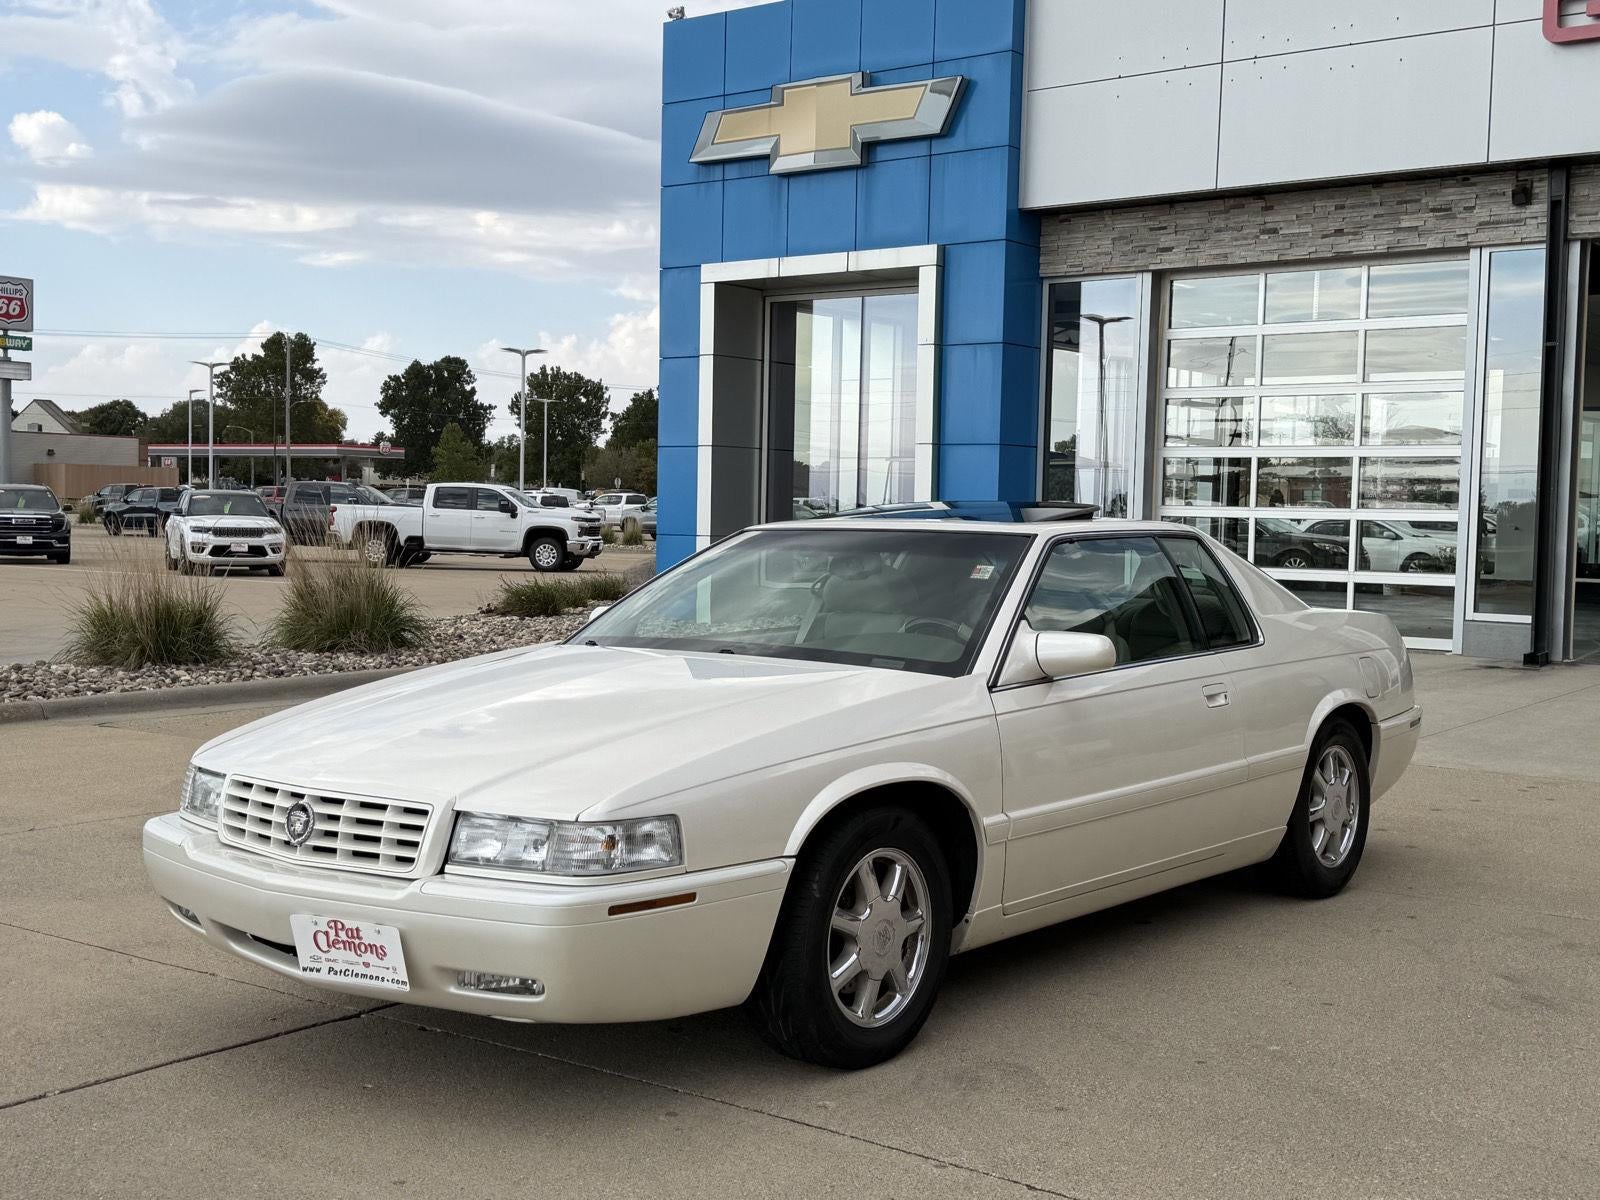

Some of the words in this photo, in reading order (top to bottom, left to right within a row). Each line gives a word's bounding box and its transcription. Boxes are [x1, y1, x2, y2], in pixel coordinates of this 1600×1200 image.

[0, 286, 24, 297] HILLIPS
[0, 298, 21, 316] 66
[0, 337, 30, 348] BWAY
[327, 919, 363, 940] Pat
[313, 930, 387, 960] Clemons
